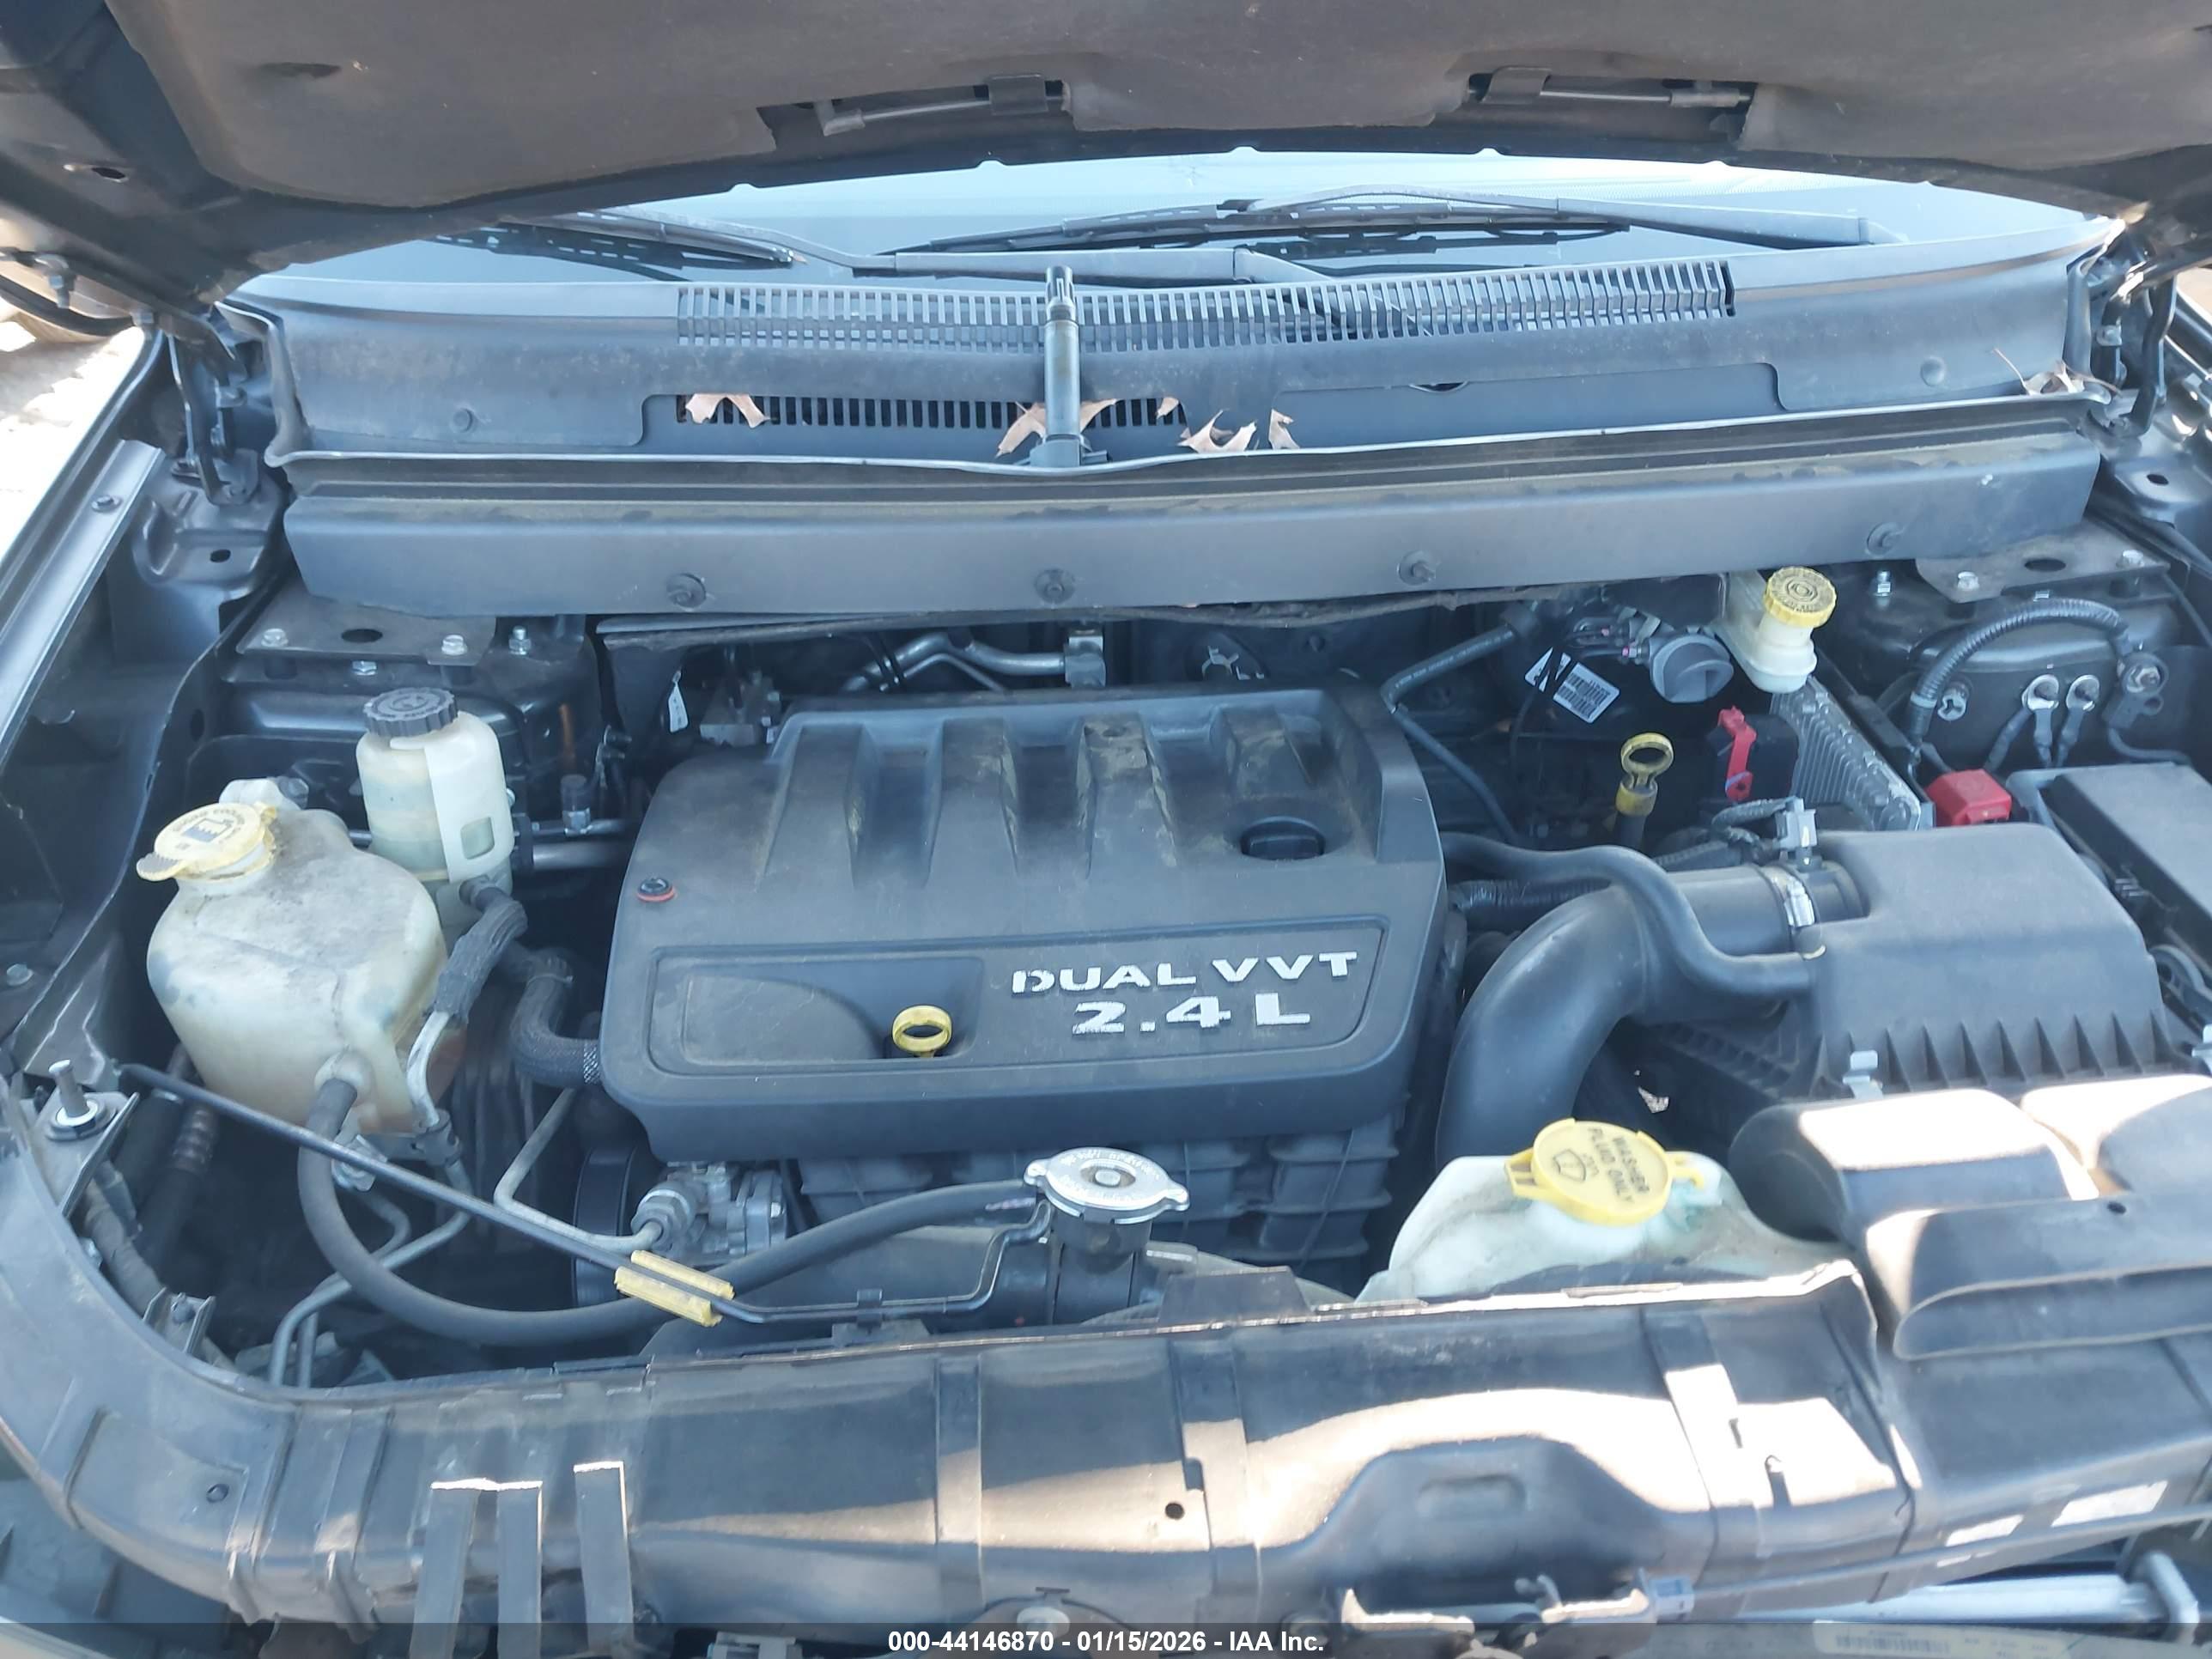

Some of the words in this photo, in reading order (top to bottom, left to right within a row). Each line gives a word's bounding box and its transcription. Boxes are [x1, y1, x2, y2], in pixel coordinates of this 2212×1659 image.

[1012, 963, 1197, 994] DUAL
[1212, 951, 1358, 983] VVT
[1607, 1169, 1634, 1203] ONLY
[1613, 1137, 1650, 1193] WASHER
